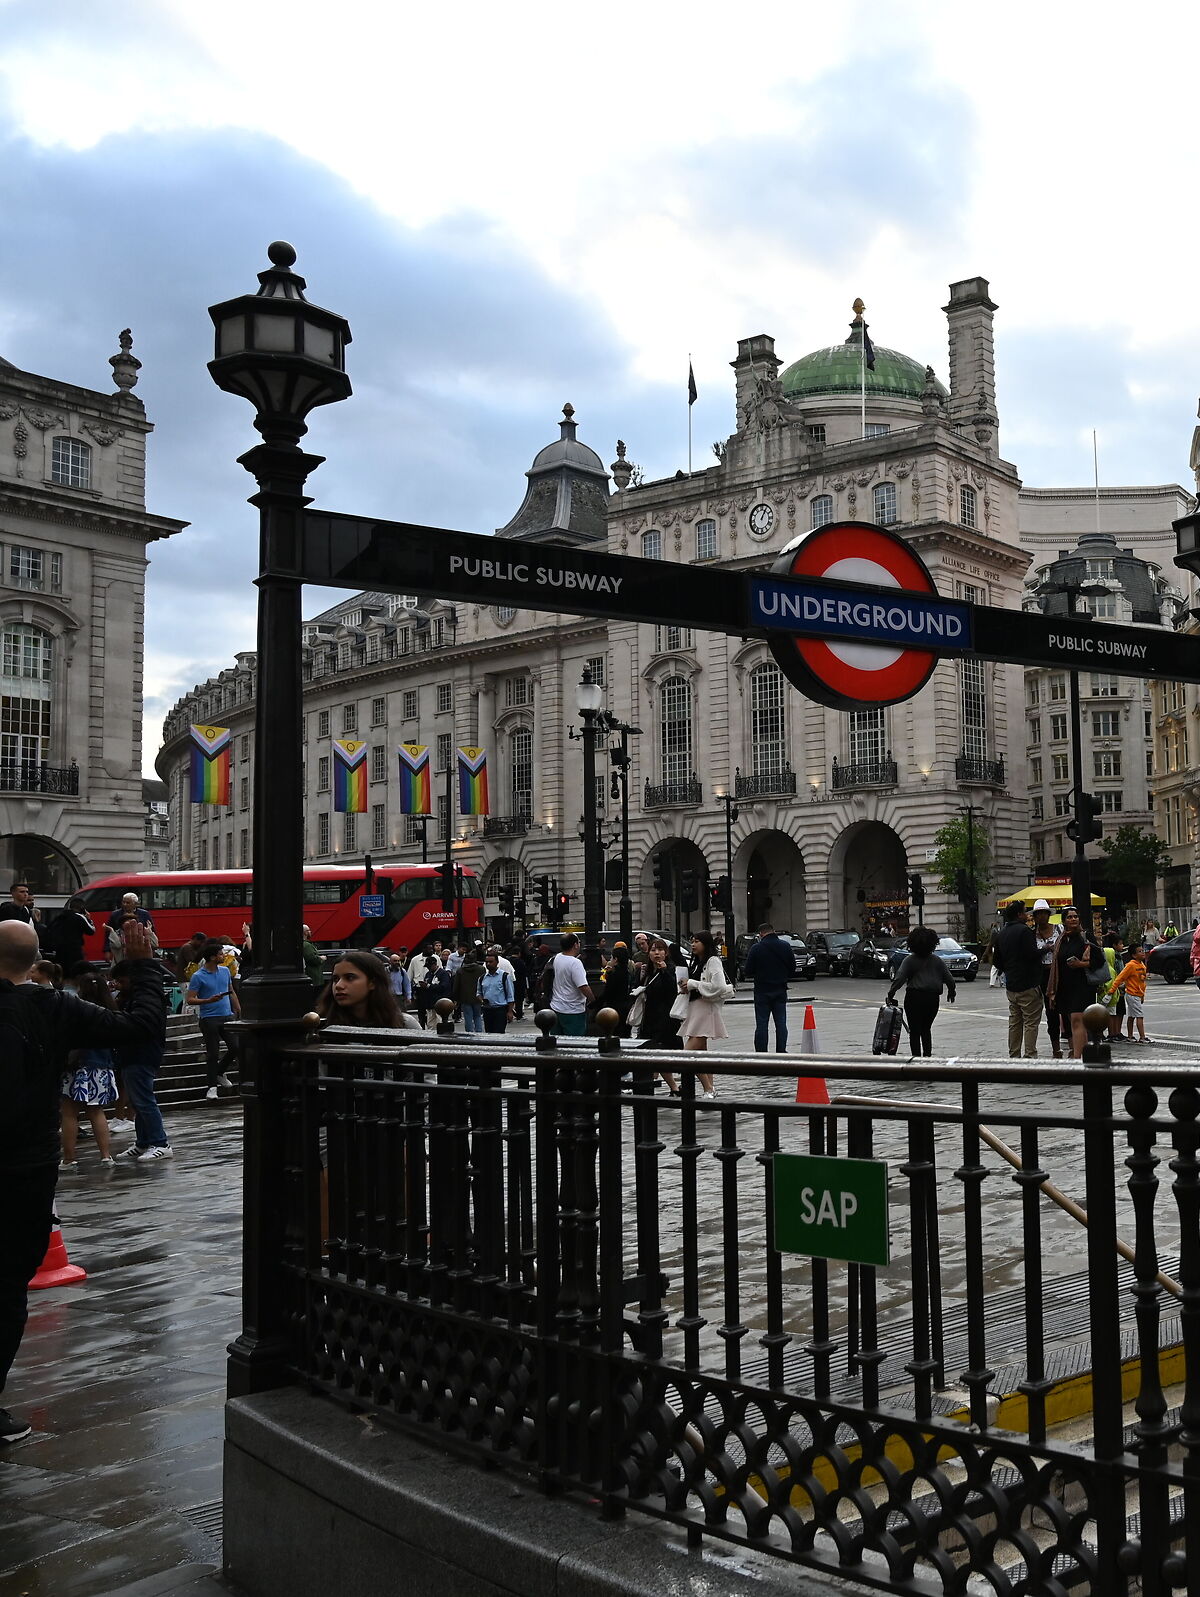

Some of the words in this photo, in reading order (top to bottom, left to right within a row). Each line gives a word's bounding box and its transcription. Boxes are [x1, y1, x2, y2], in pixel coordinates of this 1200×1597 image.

[448, 555, 529, 583] PUBLIC
[535, 566, 624, 595] SUBWAY
[942, 555, 966, 571] ALLIANCE
[758, 591, 962, 637] UNDERGROUND
[1048, 634, 1094, 652] PUBLIC
[1097, 640, 1147, 659] SUBWAY
[800, 1186, 858, 1229] SAP
